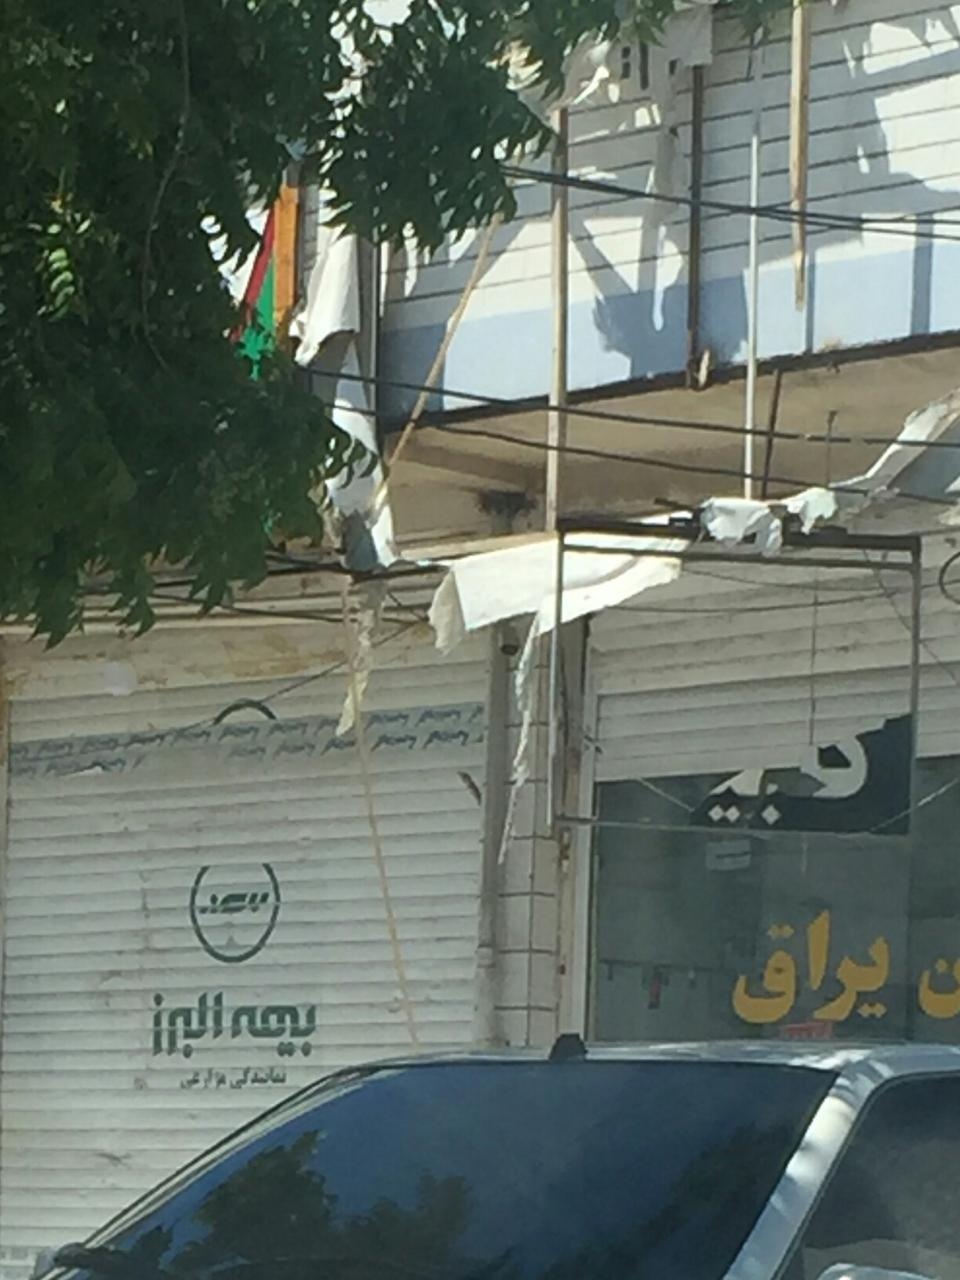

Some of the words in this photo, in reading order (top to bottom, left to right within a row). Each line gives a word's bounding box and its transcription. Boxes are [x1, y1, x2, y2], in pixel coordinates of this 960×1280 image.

[732, 909, 889, 1023] یراق
[152, 991, 223, 1058] البرز
[231, 1005, 316, 1057] بیمه
